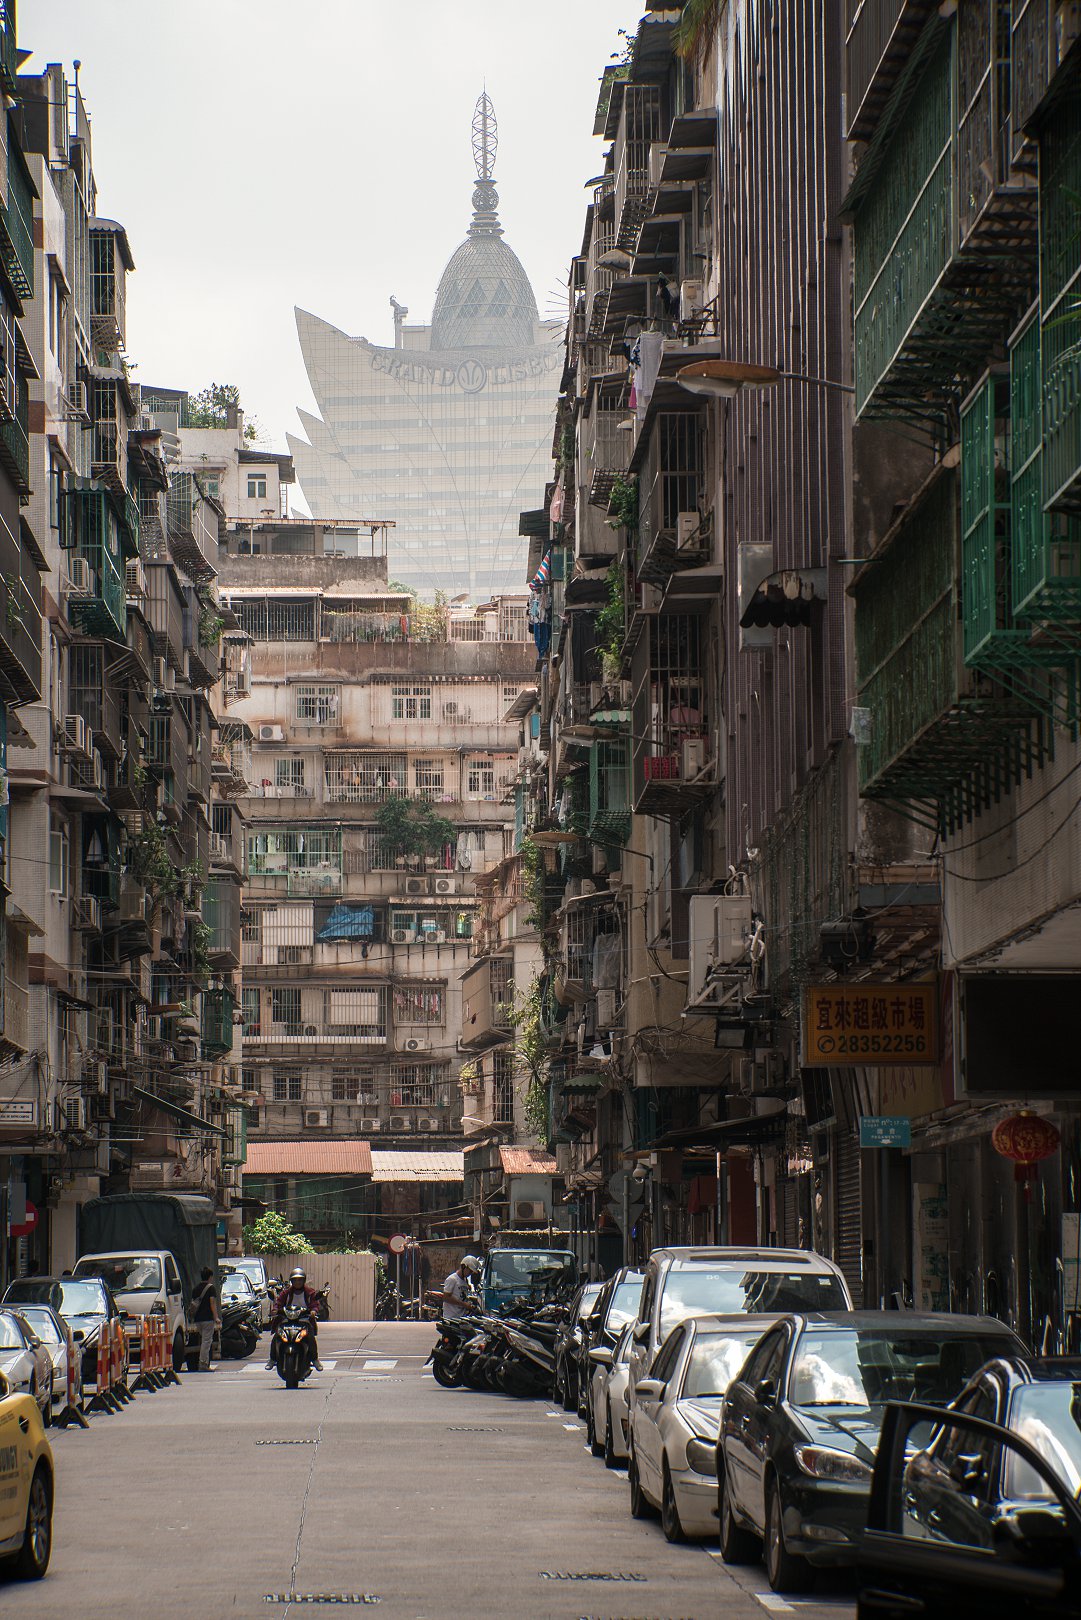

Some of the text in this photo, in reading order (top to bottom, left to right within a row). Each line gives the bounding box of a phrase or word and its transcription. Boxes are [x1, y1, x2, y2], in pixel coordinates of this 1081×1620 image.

[368, 351, 456, 386] GRAND
[816, 996, 926, 1031] 宜來超級市場
[838, 1034, 926, 1053] 28352256
